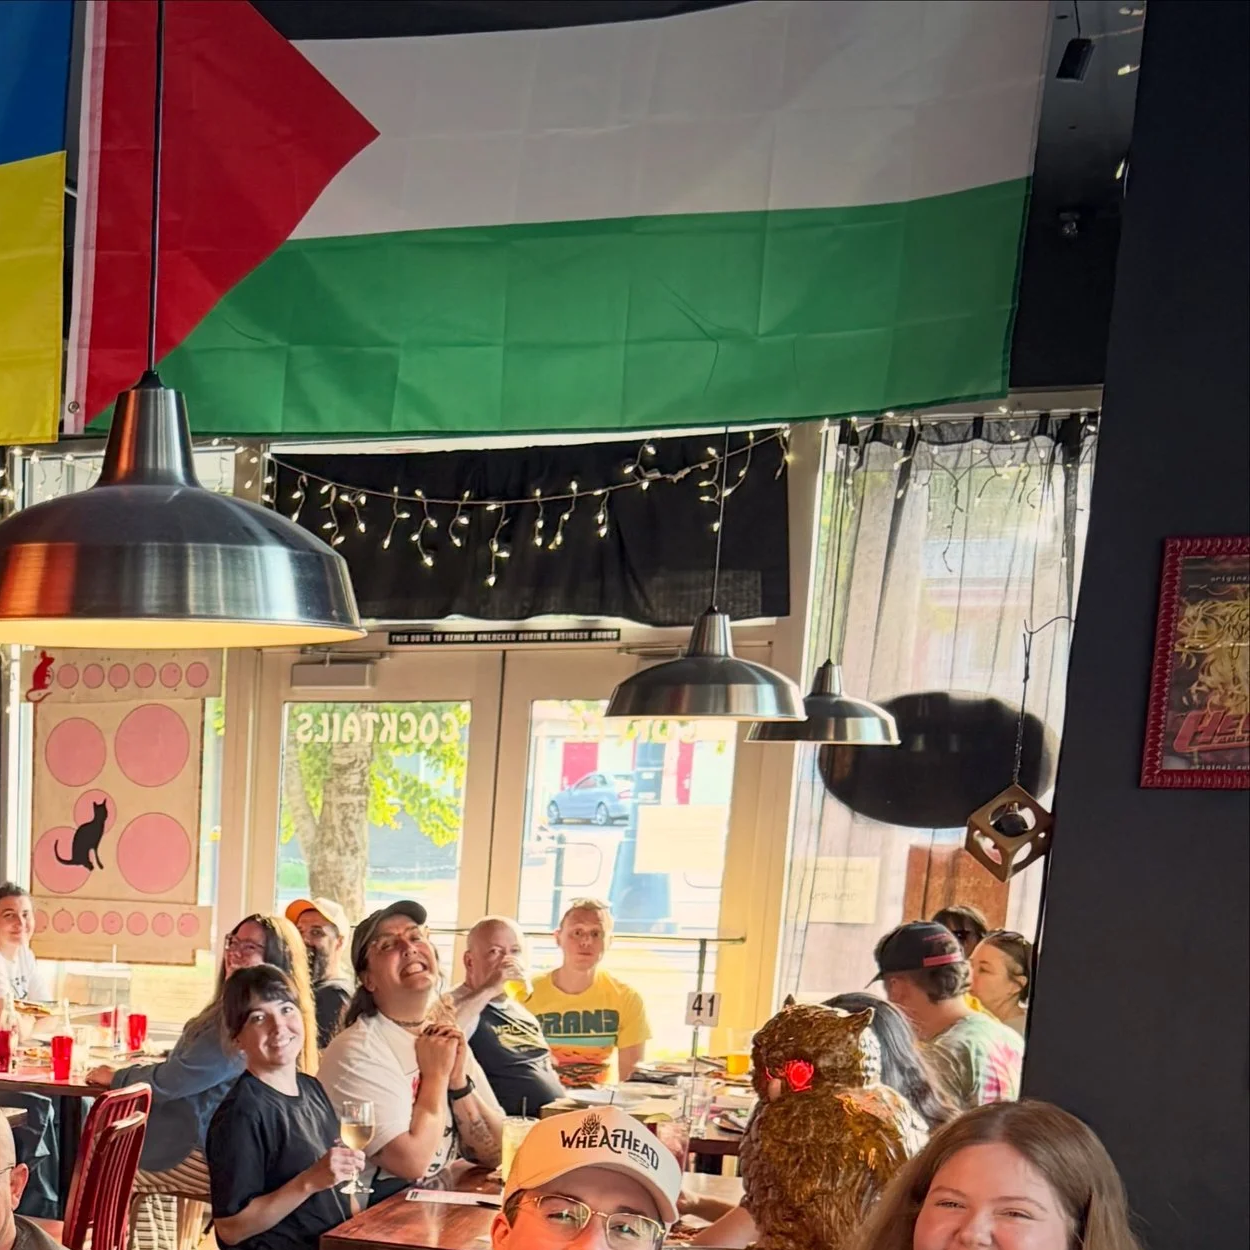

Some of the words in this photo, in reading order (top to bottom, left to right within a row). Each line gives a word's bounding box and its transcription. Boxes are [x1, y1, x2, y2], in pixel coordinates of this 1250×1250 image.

[391, 634, 408, 643] THIS
[410, 634, 431, 643] DOOR
[433, 633, 442, 642] TO
[444, 633, 475, 642] REMAIN
[477, 632, 516, 642] UNLOCKED
[518, 632, 548, 641] DURING
[550, 631, 589, 640] BUSINESS
[591, 630, 618, 640] HOURS
[691, 993, 716, 1018] 41
[560, 1124, 660, 1171] WHEATHEAD
